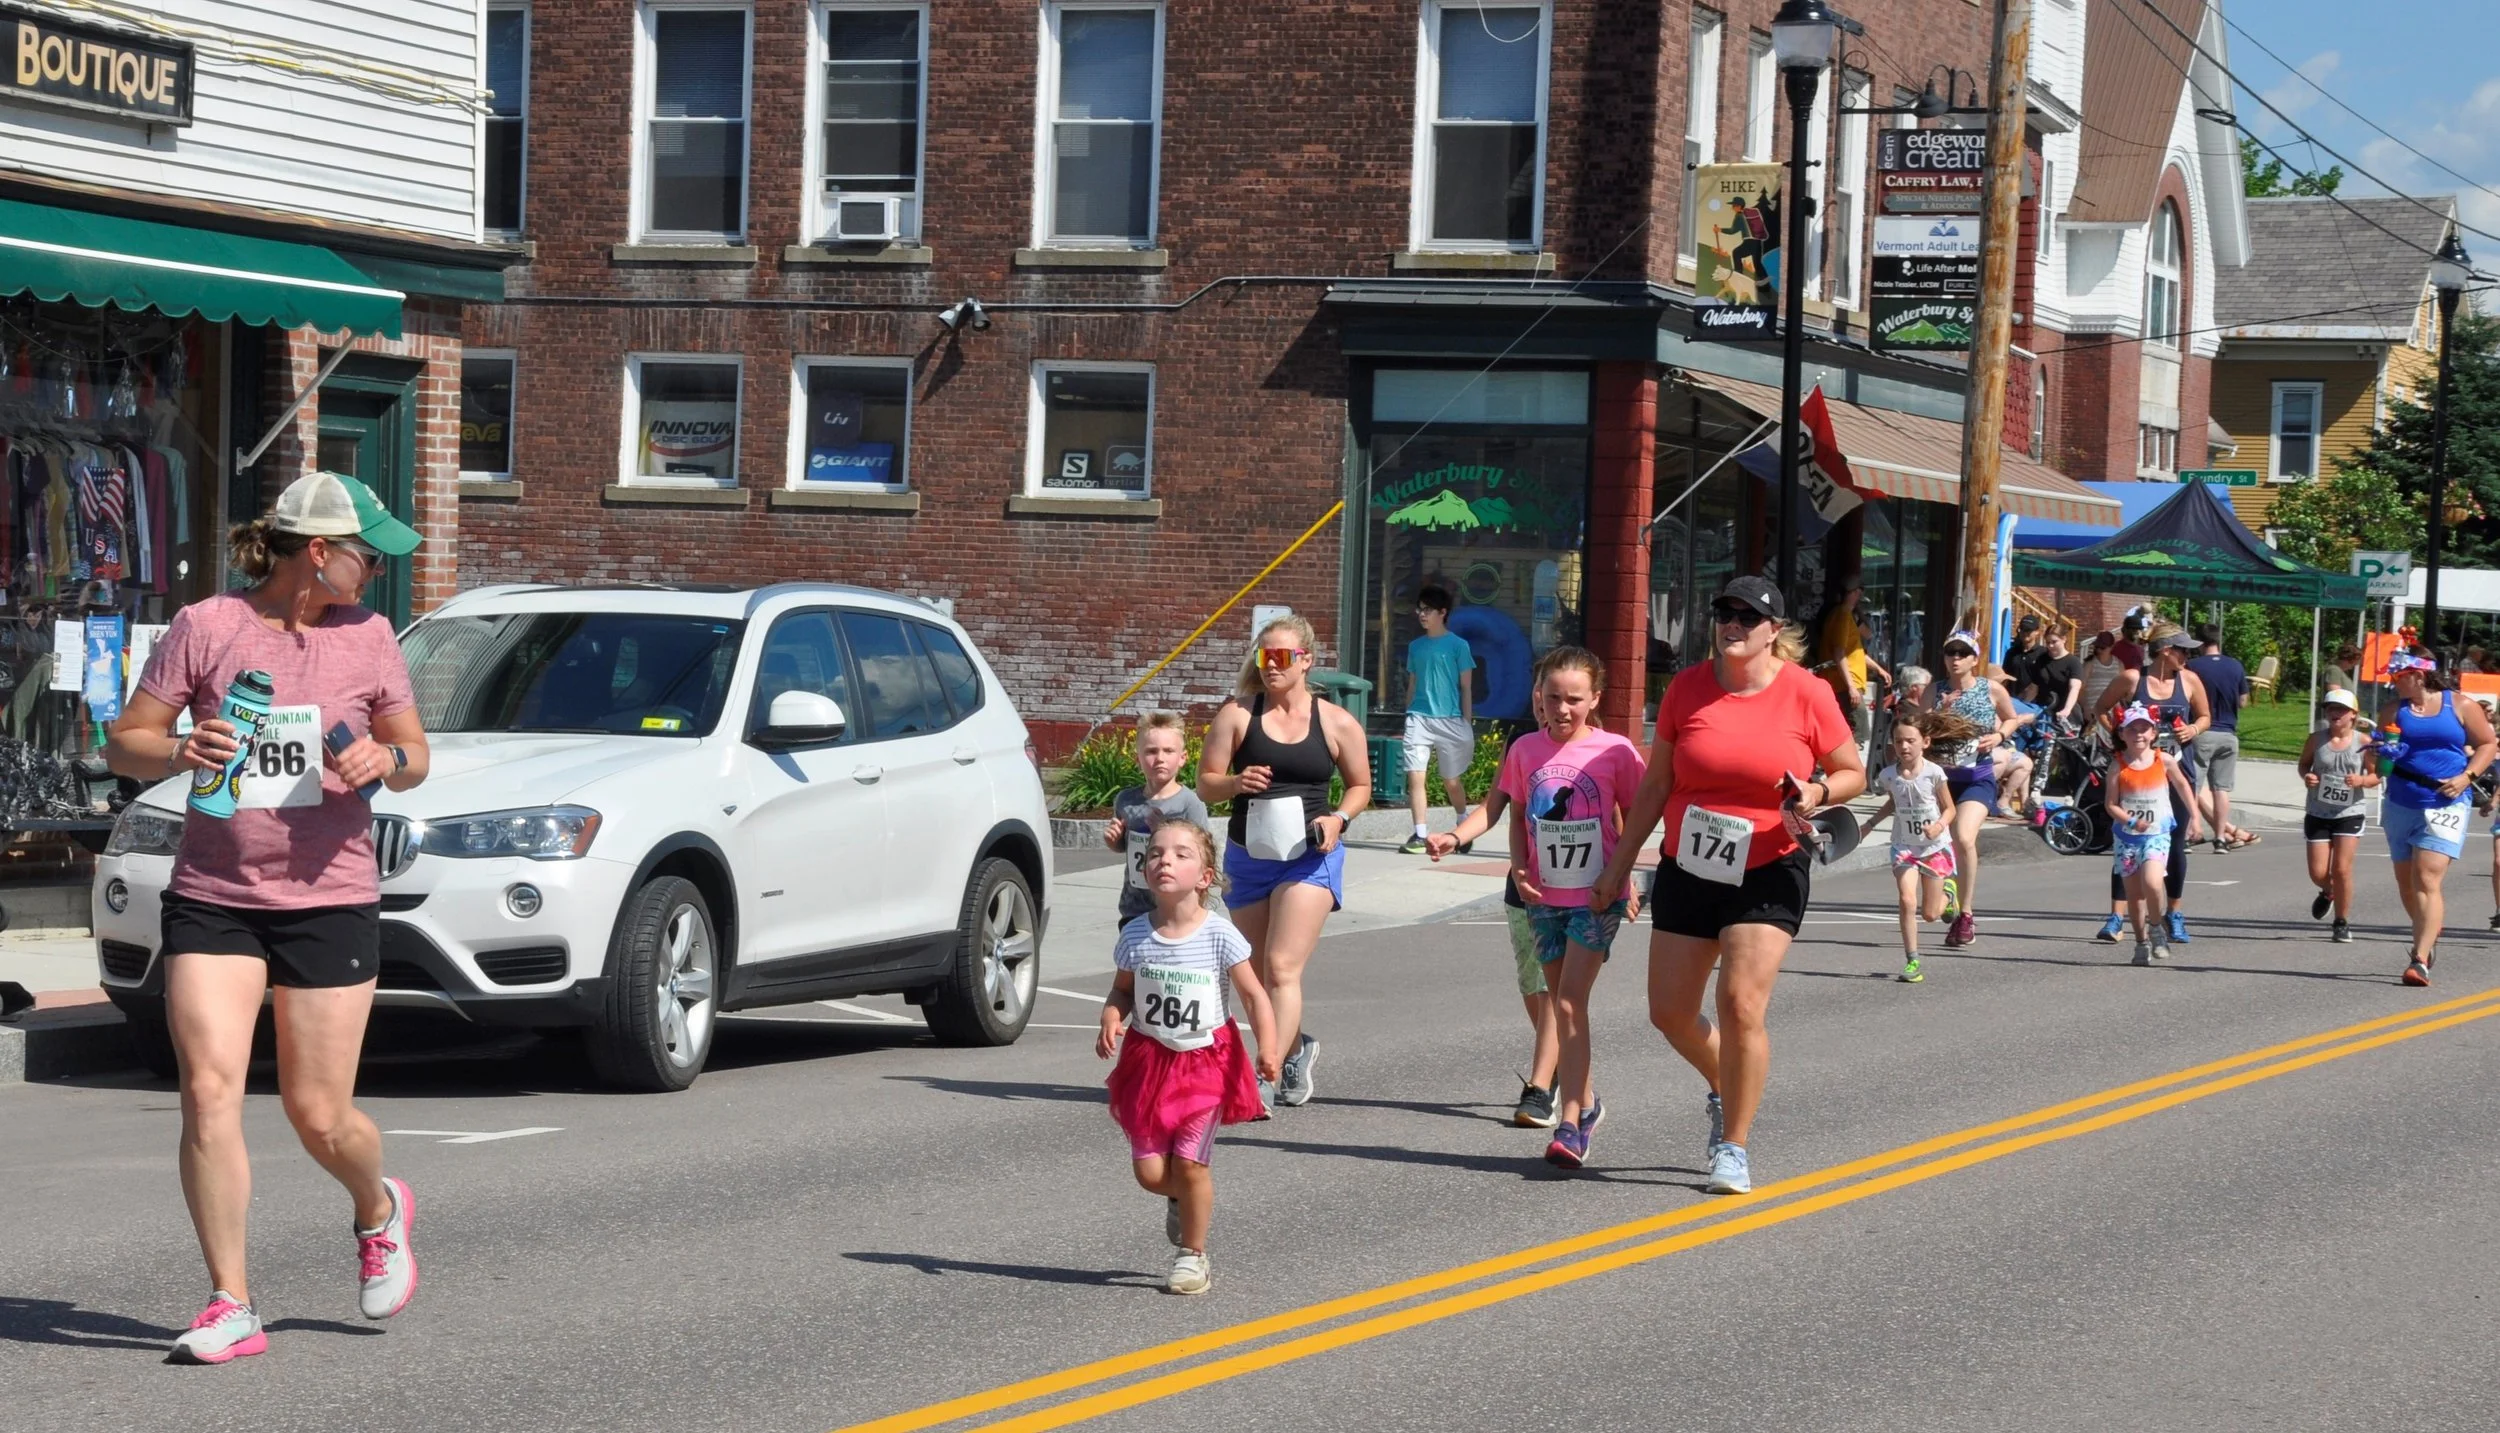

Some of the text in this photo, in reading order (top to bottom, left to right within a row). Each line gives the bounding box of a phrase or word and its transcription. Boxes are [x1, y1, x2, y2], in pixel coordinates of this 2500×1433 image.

[17, 19, 177, 105] BOUTIQUE
[1720, 181, 1756, 193] HIKE
[1885, 175, 1938, 187] CAFFRY
[1941, 175, 1973, 188] LAW,
[1876, 242, 1924, 251] Vermont
[1927, 242, 1957, 251] Adult
[1916, 264, 1932, 273] Life
[1934, 264, 1956, 273] After
[1702, 307, 1767, 329] Waterbury
[1877, 304, 1957, 334] Waterbury
[827, 455, 889, 467] GIANT
[1046, 478, 1100, 488] salomon
[1372, 462, 1504, 511] Waterbury
[2188, 473, 2248, 485] Fundry St
[85, 528, 118, 564] USA
[2023, 560, 2092, 584] Team
[2103, 567, 2189, 593] Sports
[2232, 576, 2304, 597] More
[2369, 581, 2403, 589] ARKING
[265, 712, 312, 725] OUNTAIN
[247, 740, 306, 778] 66
[193, 773, 224, 794] omorrow
[2322, 785, 2350, 802] 255
[1540, 822, 1560, 833] GREEN
[1561, 821, 1597, 834] MOUNTAIN
[1687, 808, 1748, 832] GREEN MOUNTAIN
[2430, 811, 2460, 830] 222
[1560, 833, 1576, 843] MILE
[1707, 825, 1723, 836] MILE
[1546, 842, 1593, 870] 177
[1691, 832, 1737, 867] 174
[1140, 966, 1211, 985] GREEN MOUNTAIN
[1164, 983, 1183, 996] MILE
[1145, 992, 1201, 1032] 264
